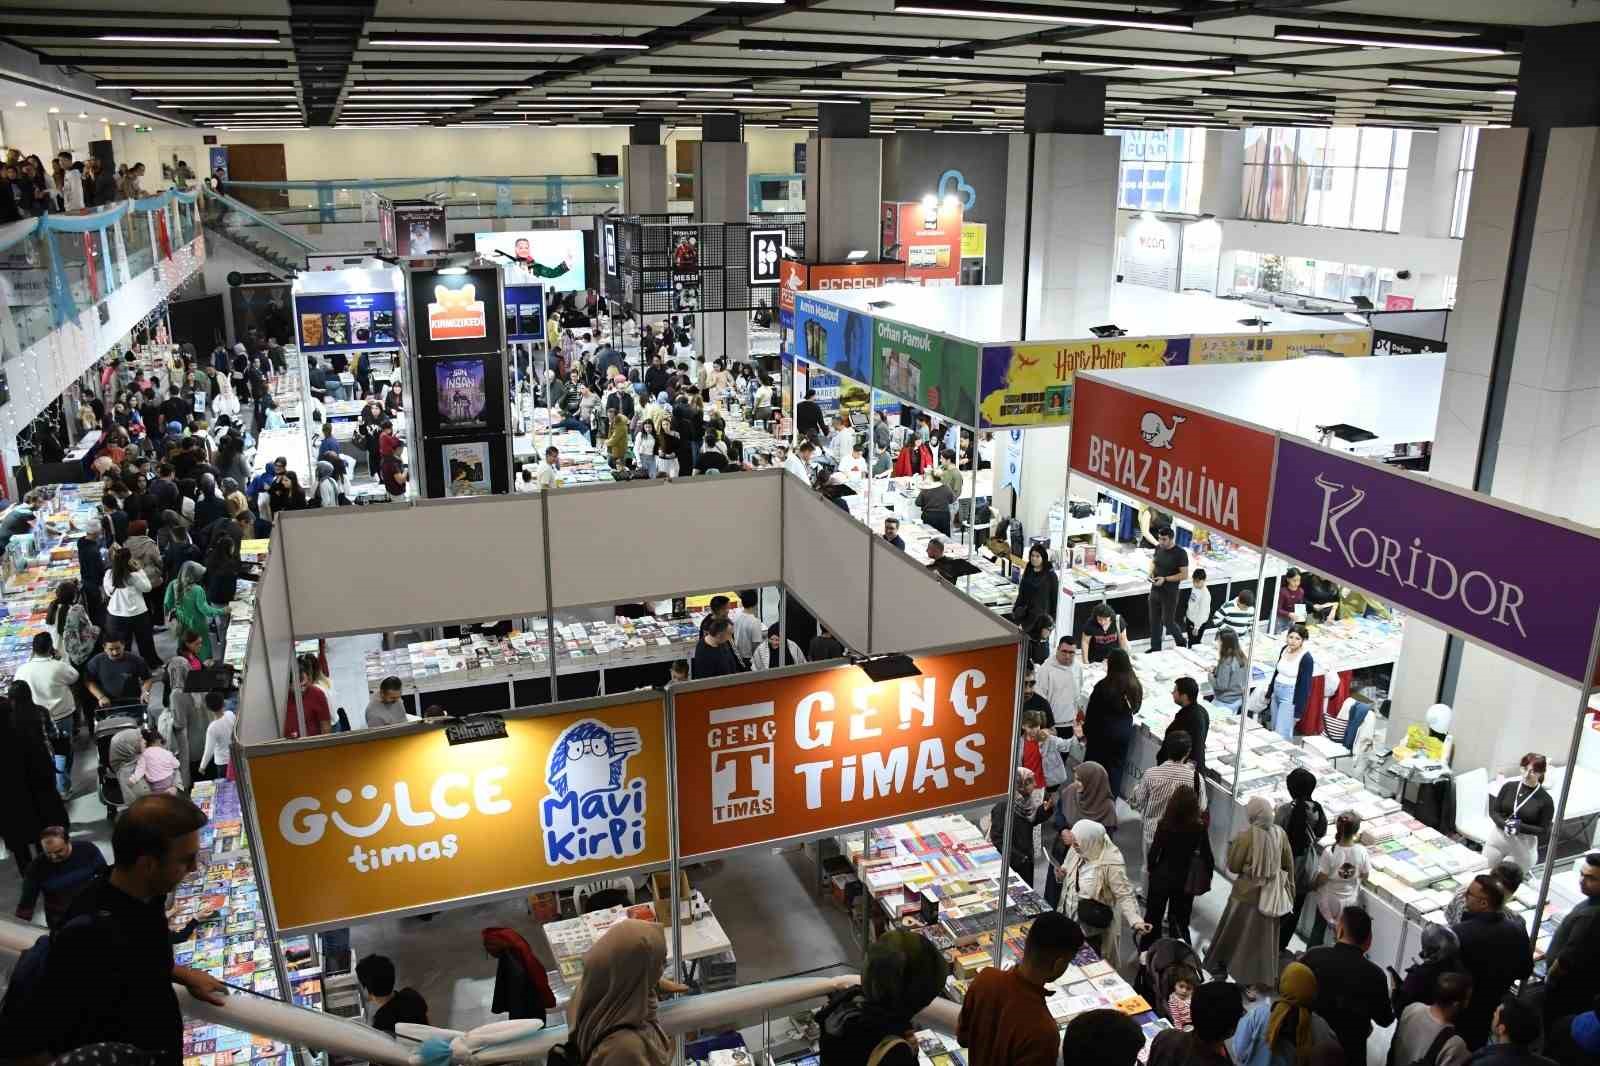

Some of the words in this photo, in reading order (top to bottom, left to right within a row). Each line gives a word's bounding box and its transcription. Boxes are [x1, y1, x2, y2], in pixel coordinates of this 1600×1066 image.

[673, 274, 699, 282] MESSI
[878, 322, 902, 343] Orhan
[902, 329, 931, 352] Pamuk
[1055, 347, 1092, 382] Harry
[1090, 343, 1126, 370] Potter
[1088, 434, 1152, 494] BEYAZ
[1156, 459, 1240, 531] BALİNA
[1310, 472, 1528, 638] KORİDOR
[794, 668, 989, 750] GENÇ
[707, 719, 777, 749] GENÇ
[278, 767, 513, 846] GÜLCE
[543, 781, 642, 827] Mavi
[348, 833, 459, 873] timaş
